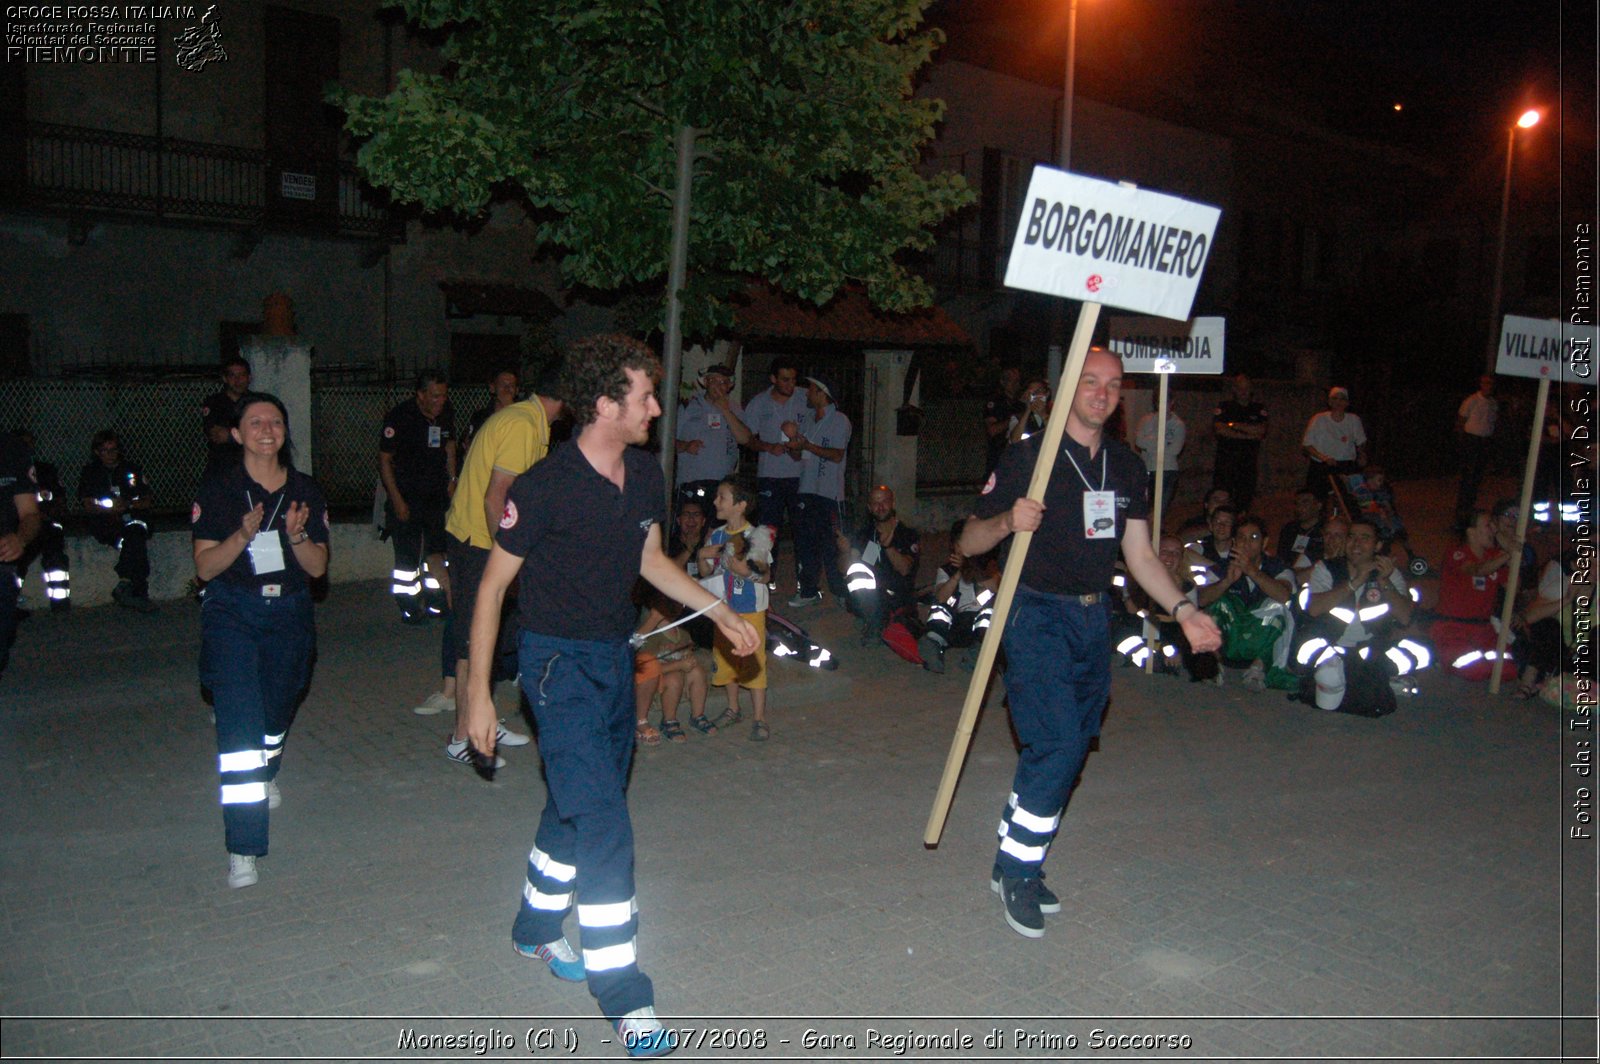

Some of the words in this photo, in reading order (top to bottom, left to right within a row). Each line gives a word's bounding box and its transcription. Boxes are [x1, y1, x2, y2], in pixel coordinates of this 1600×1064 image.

[1024, 198, 1207, 279] BORGOMANERO
[1112, 336, 1211, 358] LOMBARDIA
[1506, 333, 1588, 364] VILLANO
